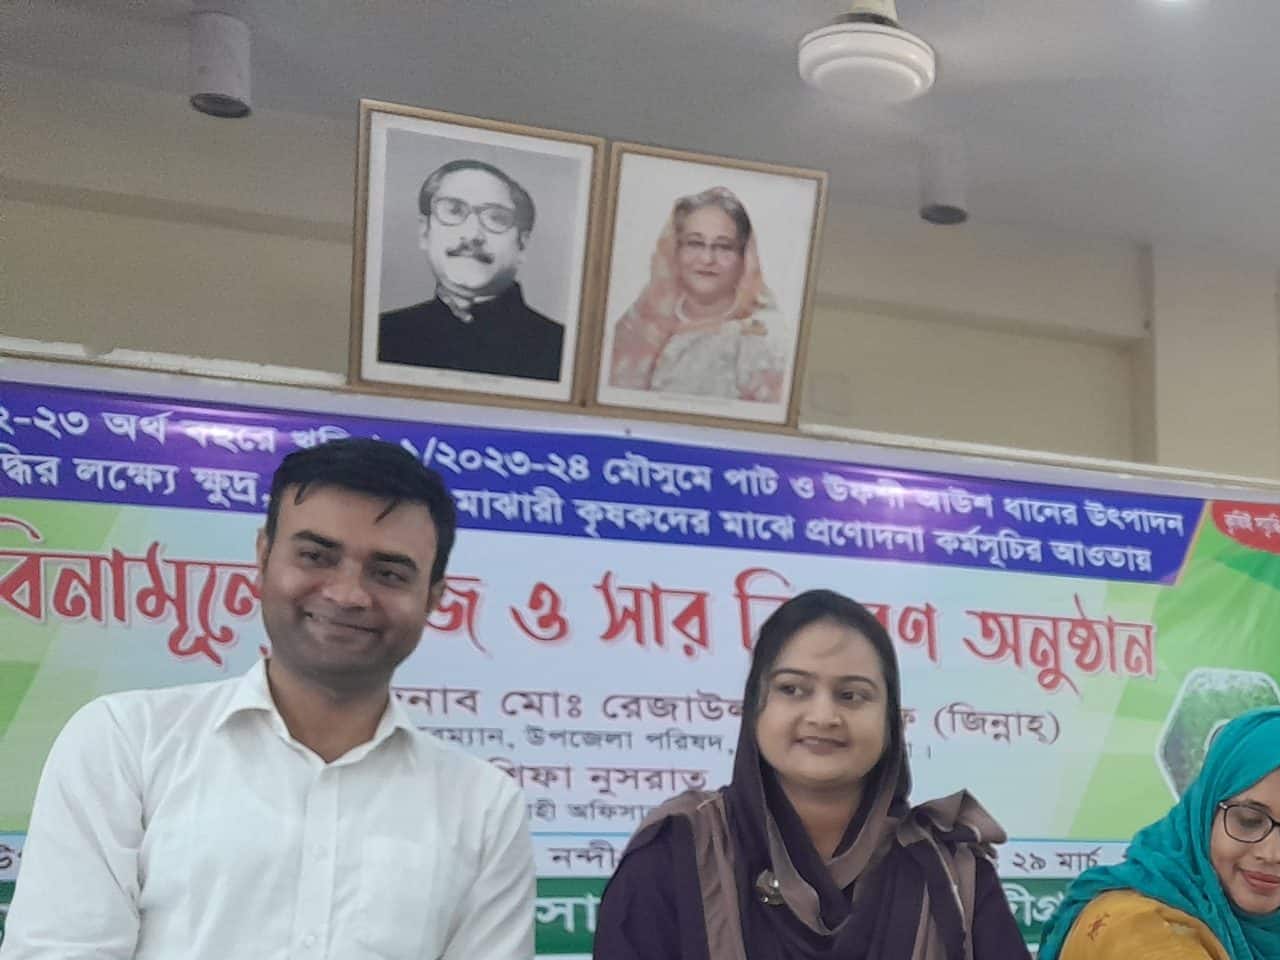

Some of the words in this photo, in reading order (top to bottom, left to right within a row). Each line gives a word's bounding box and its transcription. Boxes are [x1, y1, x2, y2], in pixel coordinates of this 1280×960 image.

[101, 411, 175, 446] অর্থ
[602, 451, 713, 496] মৌসুমে
[724, 465, 779, 496] পাট
[791, 476, 816, 499] ও
[1003, 497, 1078, 526] ধানের
[1084, 500, 1184, 538] উৎপাদন
[72, 458, 180, 495] লক্ষ্যে
[451, 486, 564, 526] মাঝারী
[572, 498, 711, 537] কৃষকদের
[719, 510, 794, 542] মাঝে
[806, 518, 924, 553] প্রণোদনা
[933, 525, 1042, 570] কর্মসূচির
[1050, 541, 1153, 574] আওতায়
[424, 576, 492, 655] জ
[511, 582, 569, 641] ও
[594, 570, 709, 656] সার
[963, 594, 1154, 694] অনুষ্ঠান
[392, 686, 480, 716] নাব
[526, 725, 632, 749] উপজেলা
[586, 767, 709, 796] নুসরাত
[568, 799, 652, 822] অফিসা
[547, 839, 623, 869] নন্দী
[1012, 852, 1046, 873] ২৯
